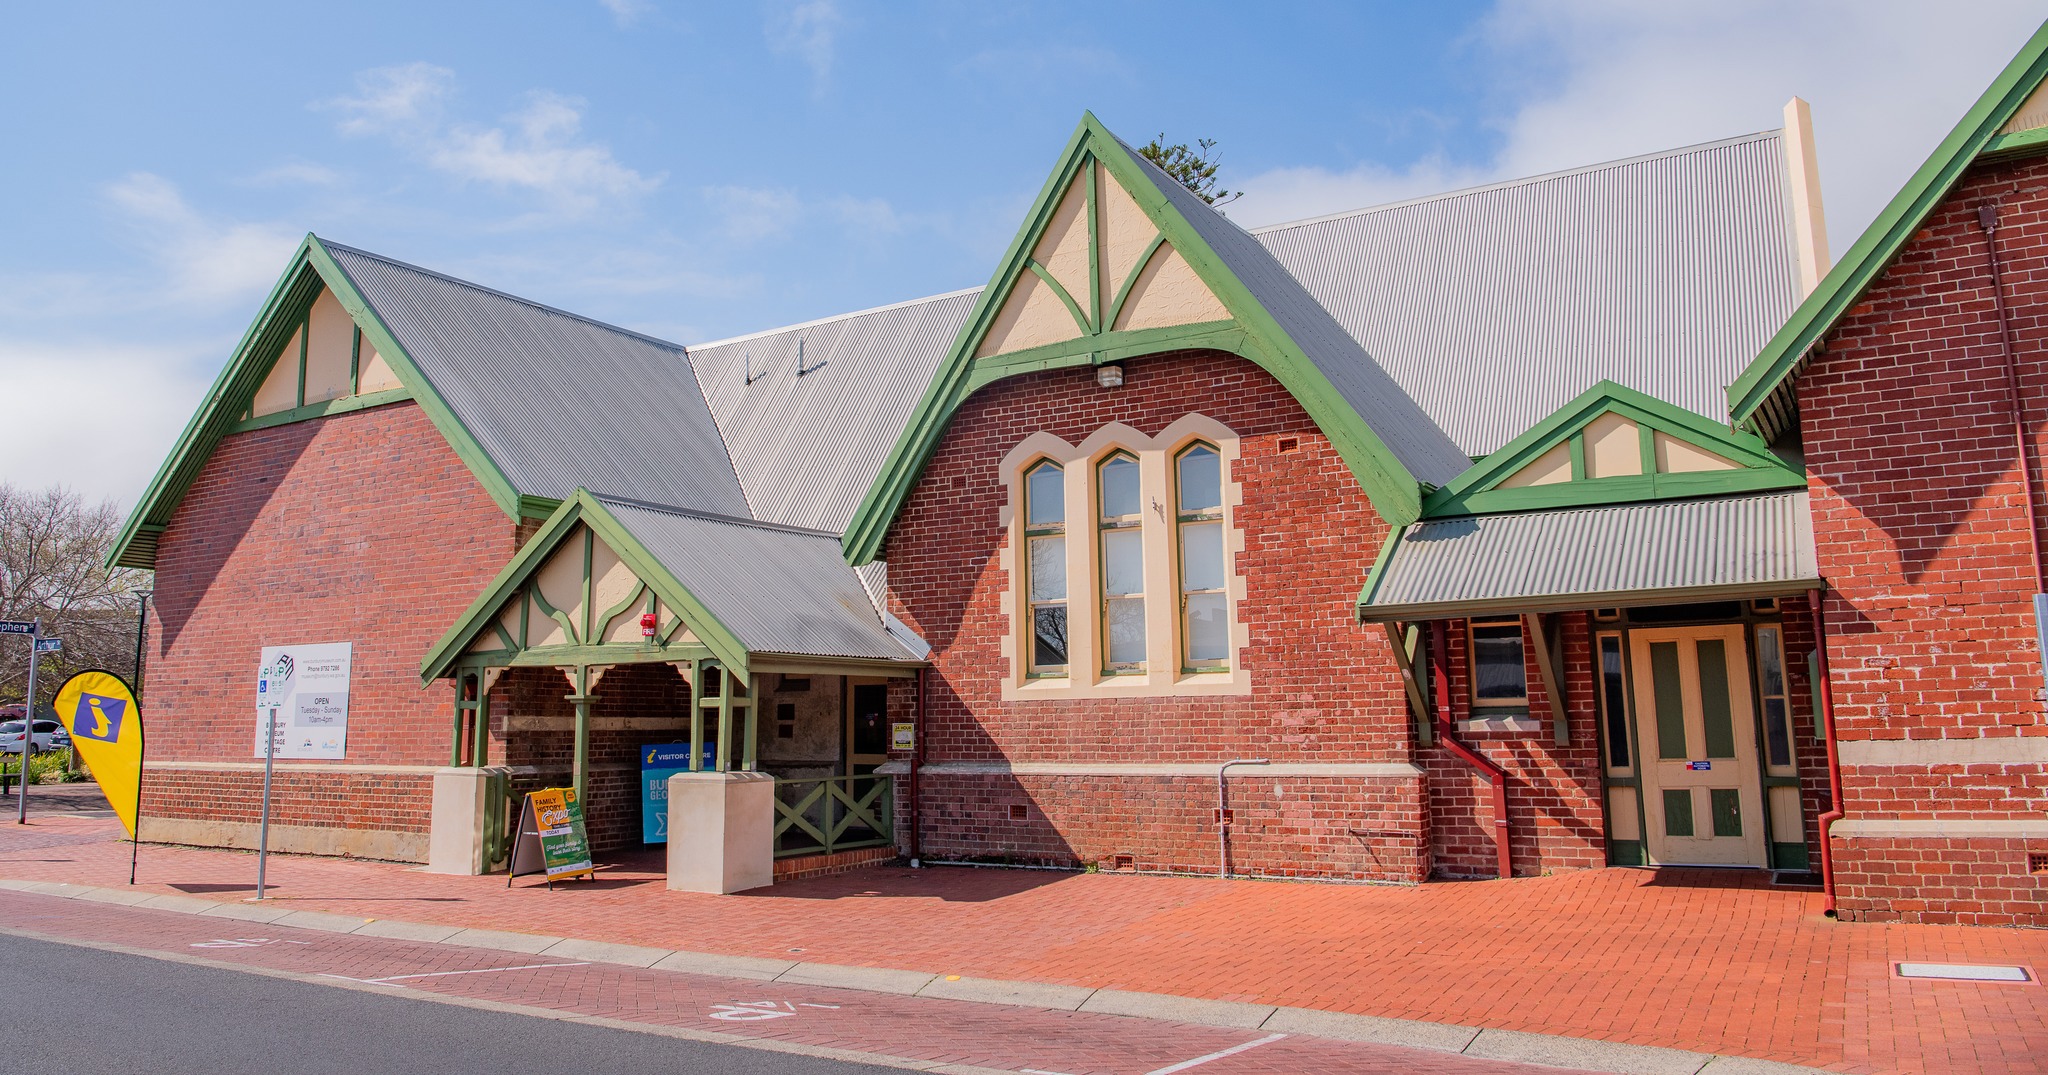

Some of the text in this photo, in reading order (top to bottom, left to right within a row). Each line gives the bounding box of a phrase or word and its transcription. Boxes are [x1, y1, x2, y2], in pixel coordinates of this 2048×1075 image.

[37, 640, 55, 650] Arthur
[314, 697, 329, 705] OPEN
[301, 706, 320, 715] Tuesday
[324, 706, 342, 715] Sunday
[309, 716, 333, 724] 10am-4pm
[535, 797, 557, 806] FAMILY
[537, 804, 561, 813] HISTORY
[542, 808, 571, 826] Expo
